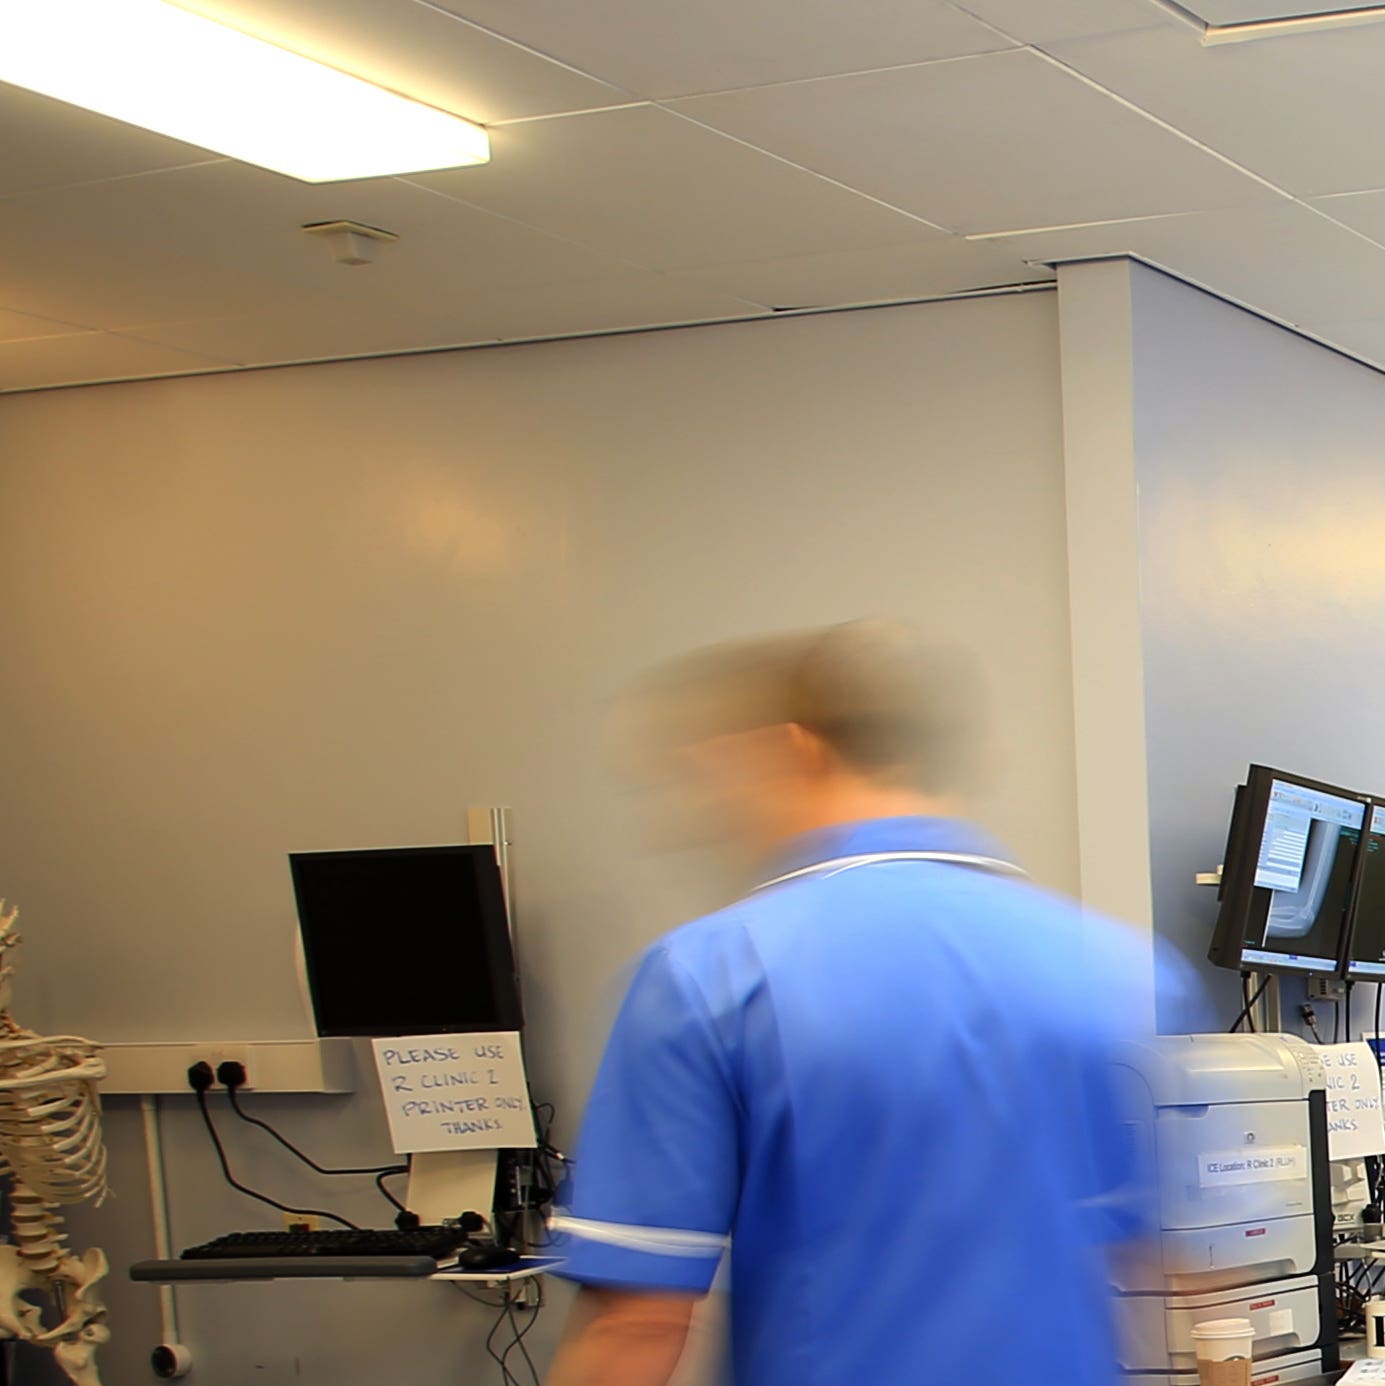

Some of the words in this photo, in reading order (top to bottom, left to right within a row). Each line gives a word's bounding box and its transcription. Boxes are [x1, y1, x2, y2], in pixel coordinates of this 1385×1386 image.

[383, 1047, 460, 1066] PLEASE
[474, 1045, 504, 1059] USE
[1338, 1052, 1358, 1067] USE
[392, 1074, 414, 1093] R
[420, 1071, 480, 1089] CLINIC
[1350, 1073, 1361, 1090] 2
[402, 1097, 489, 1117] PRINTER
[440, 1118, 503, 1135] THANKS
